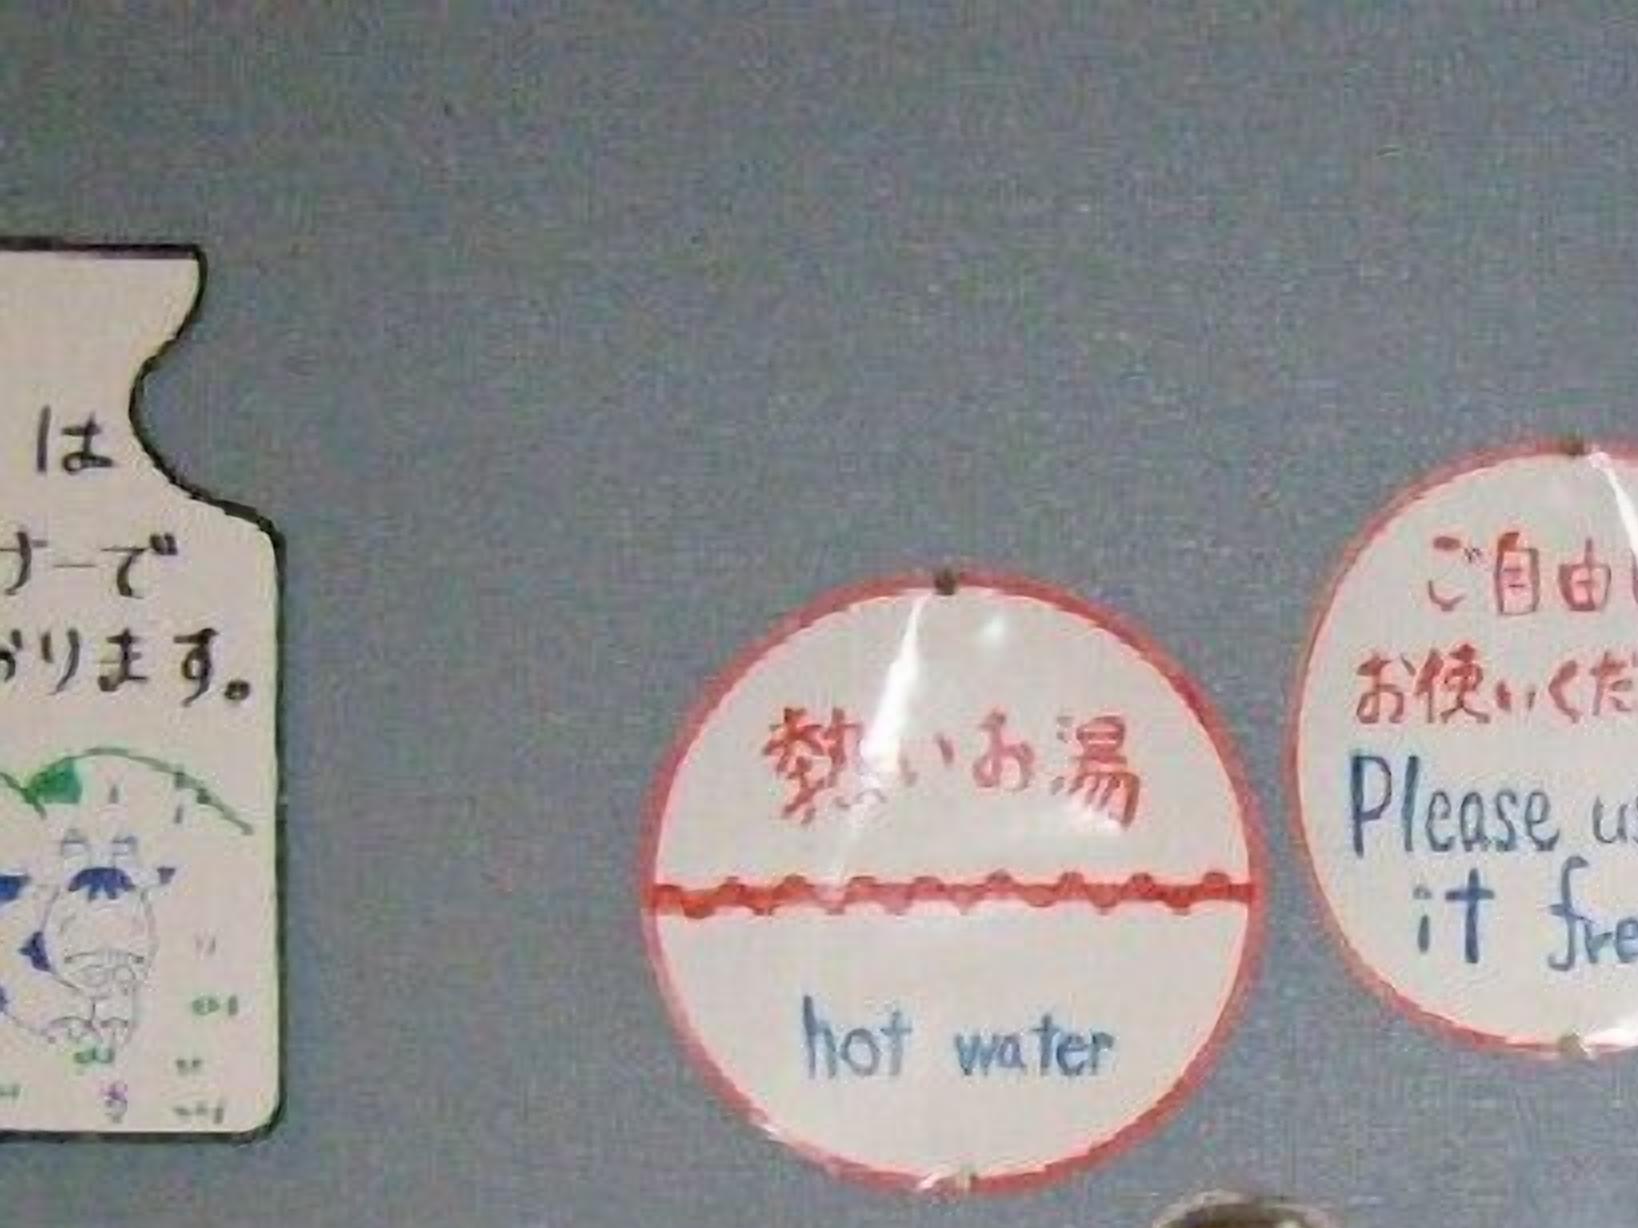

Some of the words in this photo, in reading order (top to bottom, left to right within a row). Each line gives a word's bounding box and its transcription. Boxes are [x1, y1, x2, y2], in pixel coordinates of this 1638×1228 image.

[37, 404, 117, 474] は
[763, 706, 1140, 828] 熱いお湯
[1350, 754, 1560, 859] Please
[1412, 868, 1495, 964] it
[802, 995, 912, 1079] hot
[954, 1014, 1115, 1076] water
